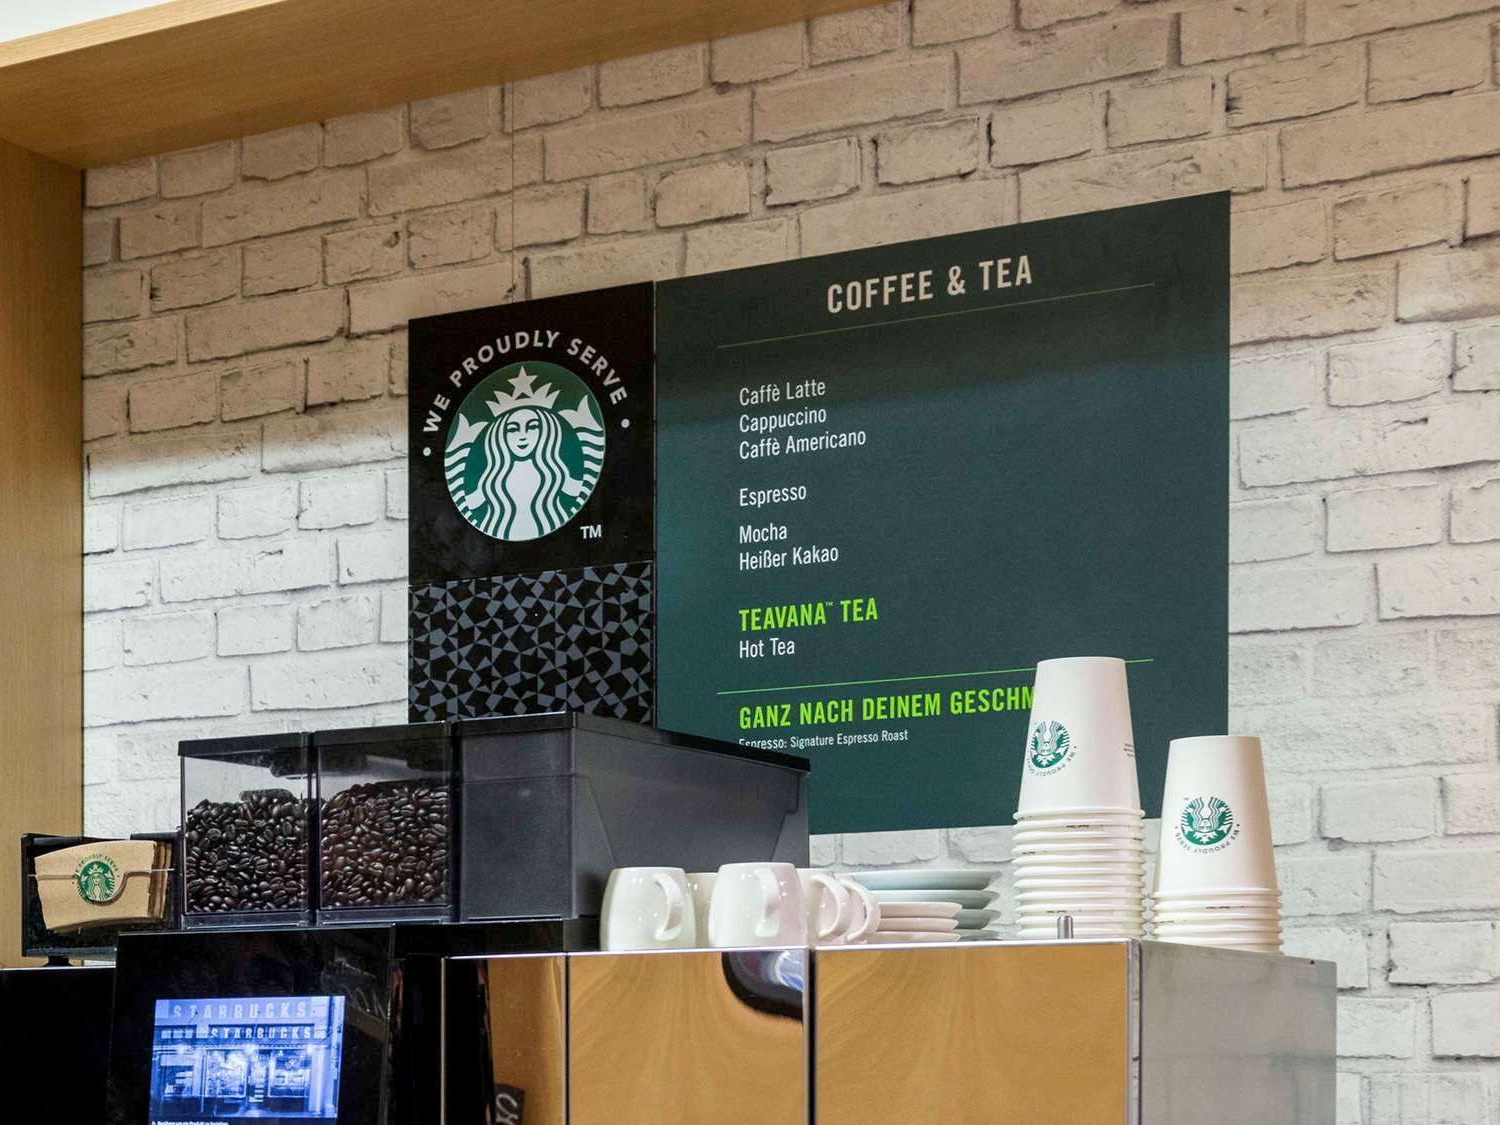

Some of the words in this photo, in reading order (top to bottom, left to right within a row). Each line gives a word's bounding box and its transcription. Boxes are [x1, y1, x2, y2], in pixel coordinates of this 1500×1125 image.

[827, 269, 934, 314] COFFEE
[947, 265, 966, 296] &
[978, 255, 1033, 292] TEA
[423, 393, 450, 433] WE
[449, 329, 561, 388] PROUDLY
[566, 338, 627, 405] SERVE
[739, 383, 781, 406] Caffè
[786, 379, 826, 400] Latte
[739, 406, 827, 434] Cappuccino
[739, 437, 781, 460] Caffè
[785, 430, 867, 455] Americano
[739, 485, 807, 508] Espresso
[580, 524, 602, 539] TM
[739, 522, 788, 544] Mocha
[739, 549, 788, 571] Heißer
[792, 545, 839, 566] Kakao
[840, 597, 878, 622] TEA
[739, 639, 765, 659] Hot
[769, 637, 796, 656] Tea
[739, 703, 791, 730] GANZ
[799, 699, 853, 726] NACH
[862, 692, 941, 722] DEINEM
[950, 686, 1035, 715] GESCHM
[790, 735, 834, 750] Signature
[837, 732, 879, 747] Espresso
[881, 729, 909, 742] Roast
[211, 1026, 312, 1040] STARBUCKS
